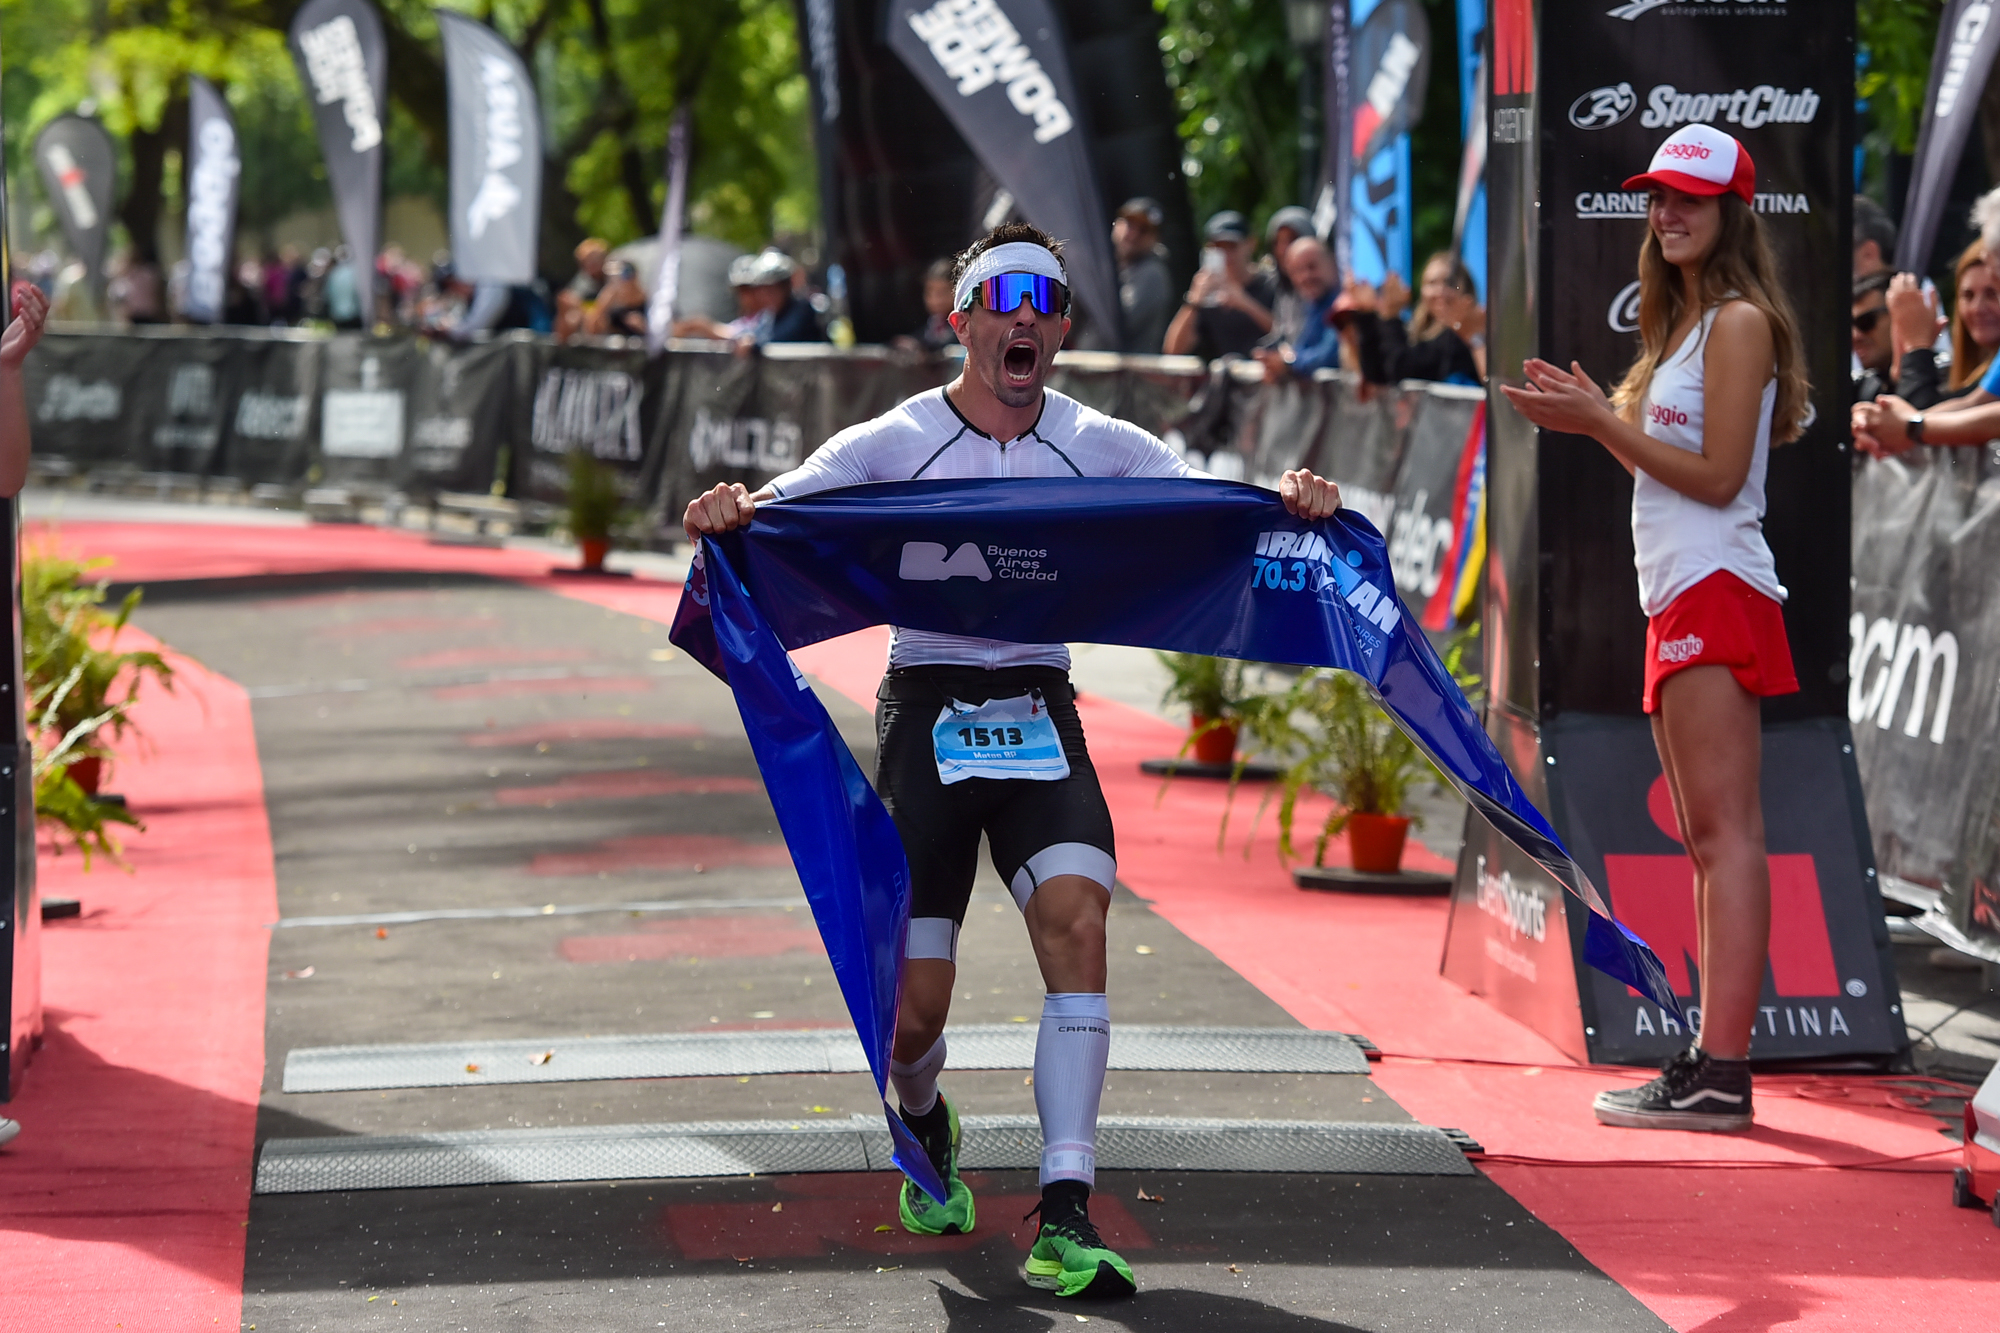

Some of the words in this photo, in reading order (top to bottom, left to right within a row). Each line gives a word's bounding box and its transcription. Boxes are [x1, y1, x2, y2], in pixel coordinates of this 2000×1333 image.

[1640, 84, 1821, 129] SportClub
[899, 541, 992, 582] BA
[987, 545, 1048, 559] Buenos
[995, 557, 1041, 570] Aires
[998, 568, 1059, 582] Ciudad
[1252, 557, 1306, 592] 70.3
[957, 727, 1024, 747] 1513
[1634, 1006, 1850, 1037] ARGTINA
